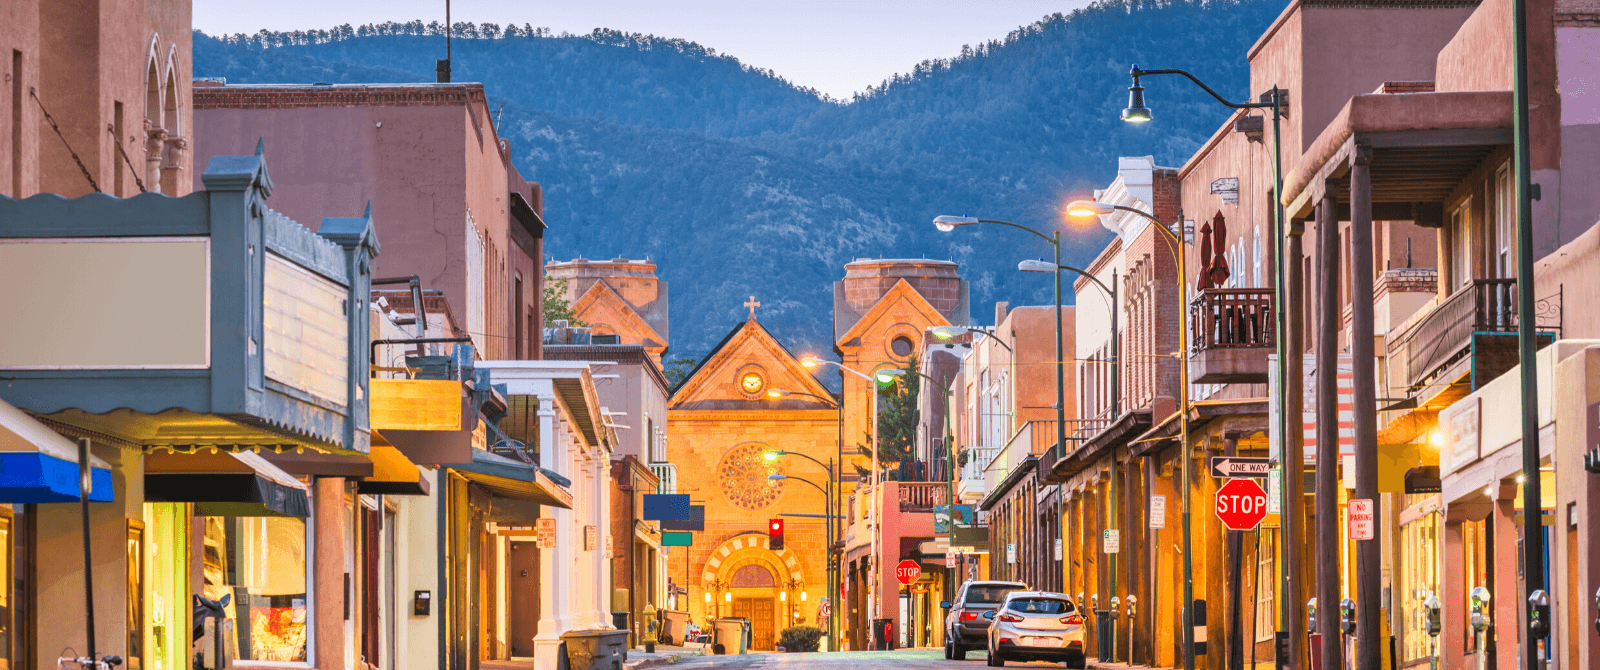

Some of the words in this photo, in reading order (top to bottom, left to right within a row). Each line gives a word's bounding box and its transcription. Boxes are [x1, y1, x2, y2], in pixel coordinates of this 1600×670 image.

[1230, 463, 1246, 471] ONE
[1250, 463, 1267, 471] WAY
[1217, 494, 1266, 514] STOP
[1356, 503, 1366, 511] NO
[1349, 513, 1372, 521] PARKING
[897, 567, 919, 577] STOP
